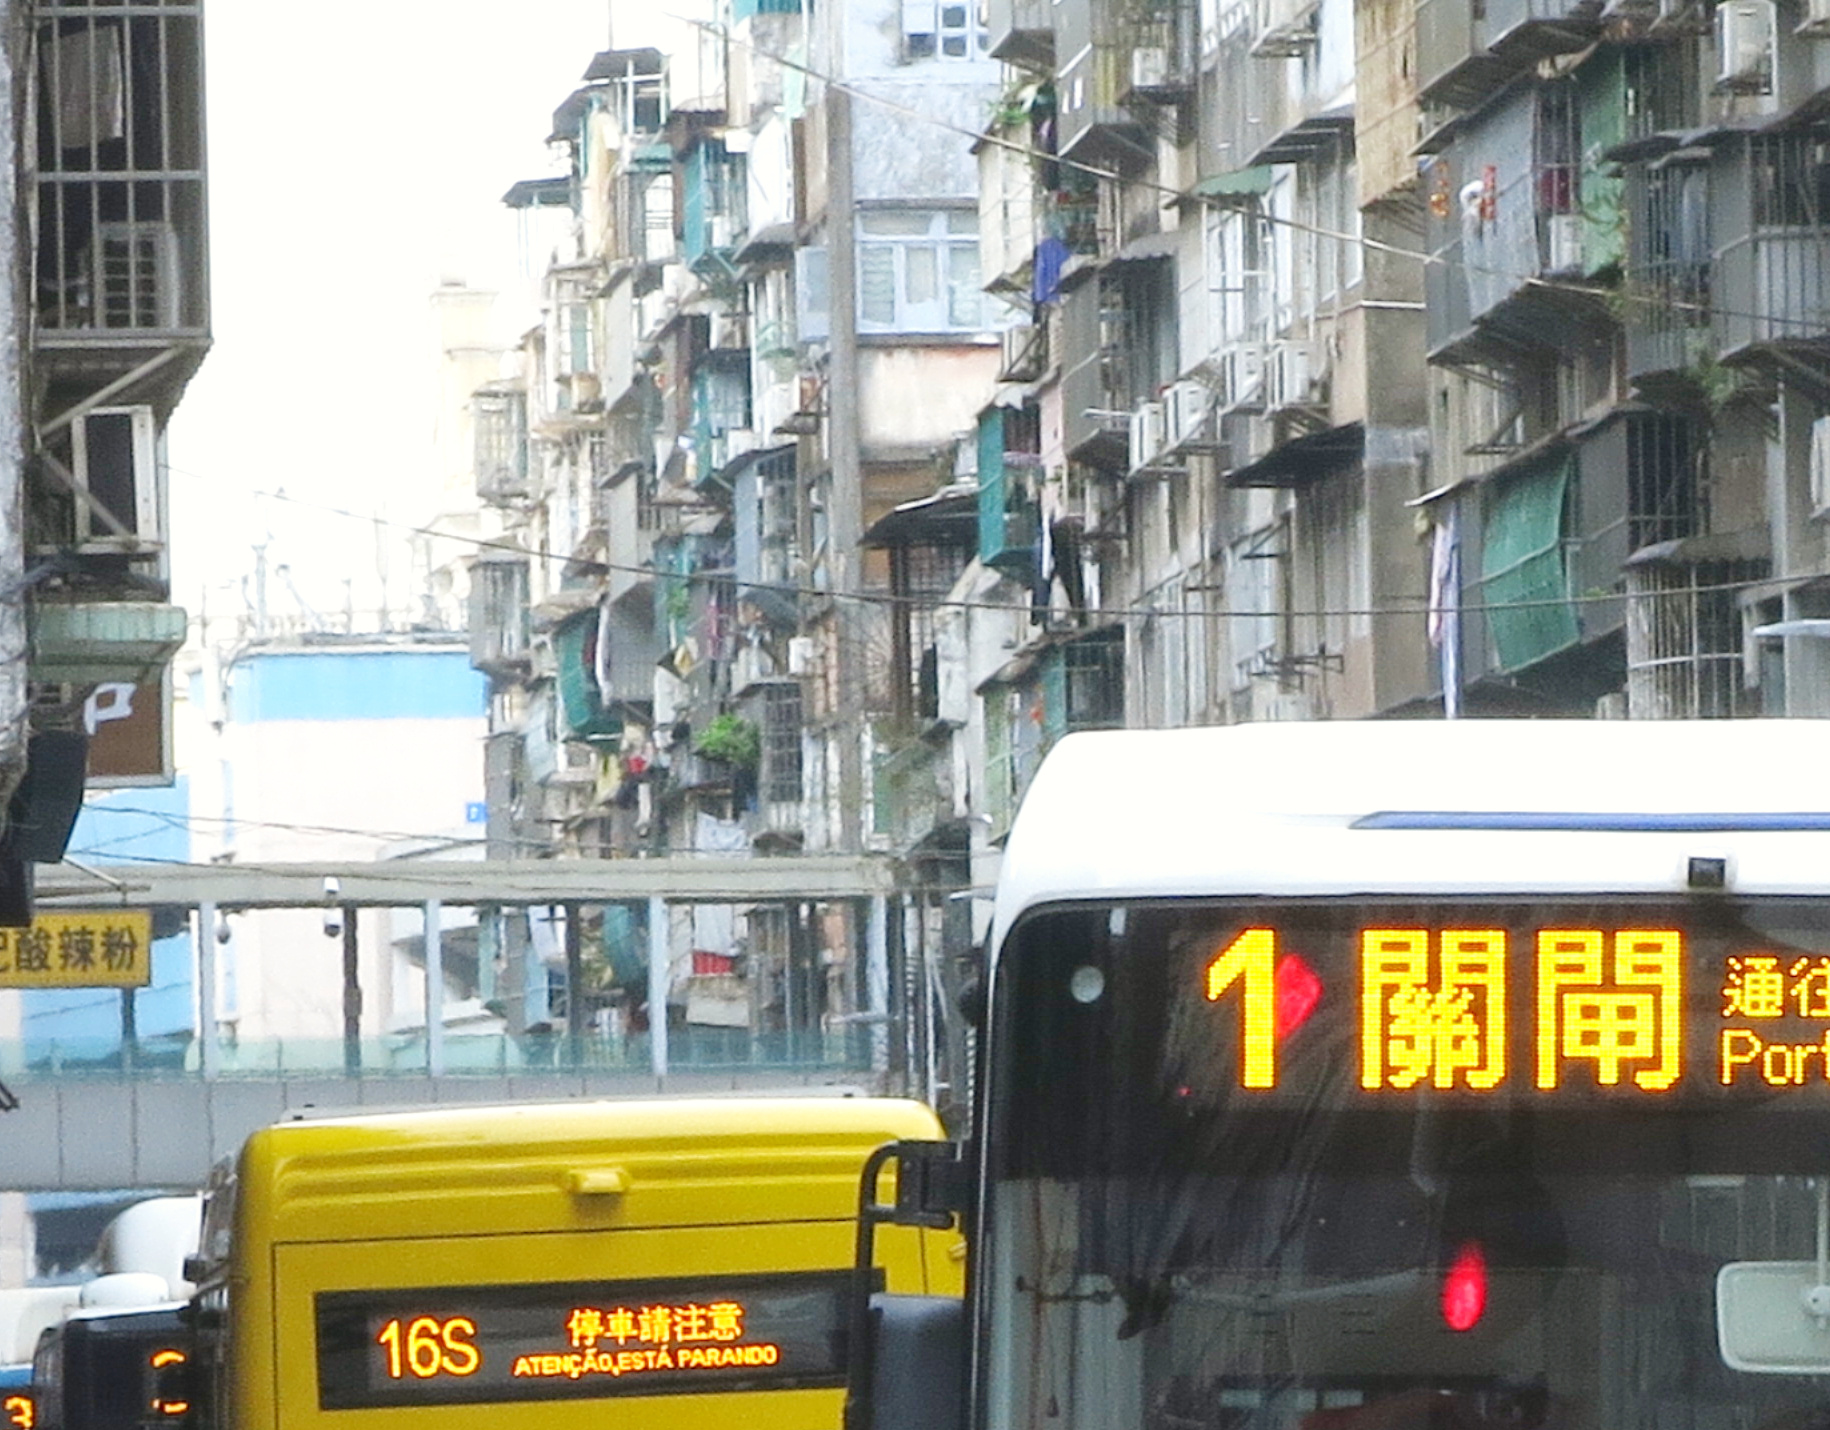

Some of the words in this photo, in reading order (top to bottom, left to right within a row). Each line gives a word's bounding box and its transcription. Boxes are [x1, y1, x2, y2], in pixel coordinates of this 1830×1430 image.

[1206, 928, 1277, 1090] 1
[1362, 928, 1681, 1090] 關閘
[379, 1317, 481, 1378] 16S
[567, 1302, 744, 1347] 停車請注意
[677, 1345, 779, 1368] PARANDO
